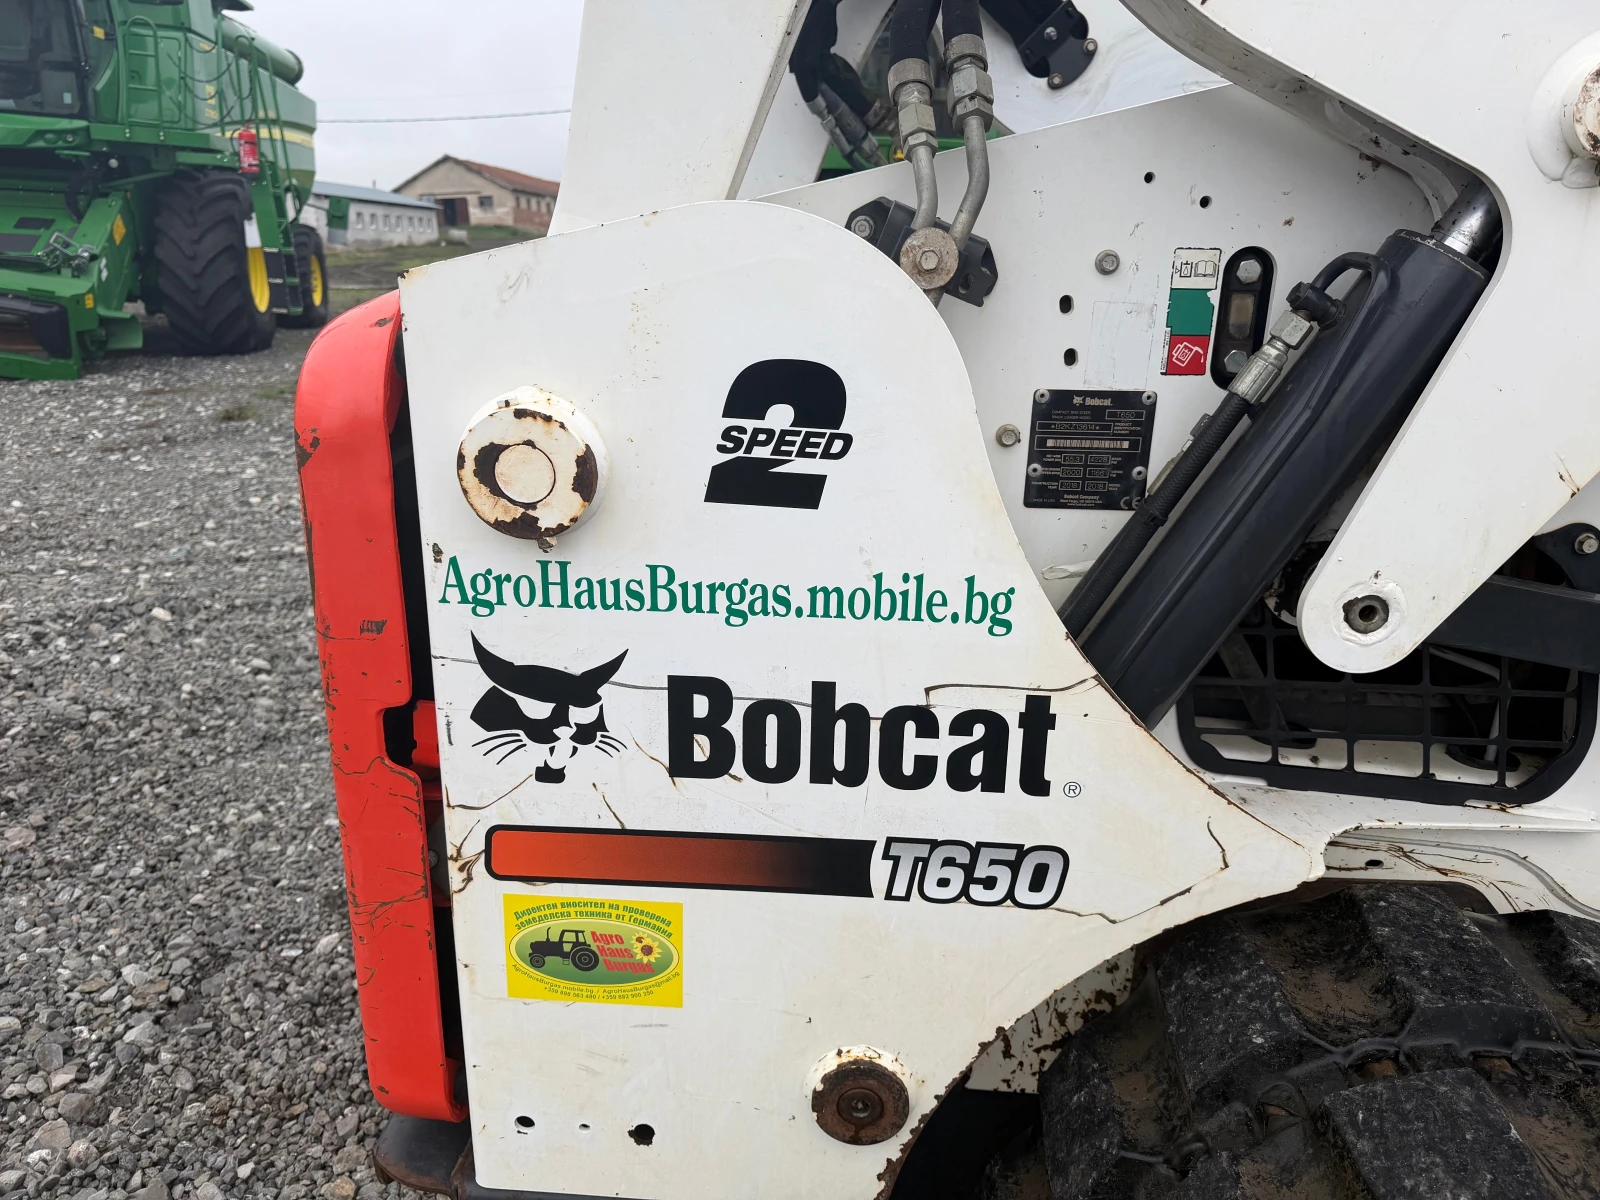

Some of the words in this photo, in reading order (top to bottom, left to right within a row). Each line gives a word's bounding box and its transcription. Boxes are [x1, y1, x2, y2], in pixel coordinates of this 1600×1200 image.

[704, 359, 847, 510] 2
[715, 425, 854, 461] SPEED
[439, 555, 1015, 637] AgroHausBurgas.mobile.bg
[667, 674, 1058, 797] Bobcat
[882, 837, 1071, 910] T650
[513, 902, 558, 921] Директен
[560, 901, 605, 910] вносител
[609, 903, 620, 911] на
[622, 906, 672, 927] проверена
[515, 910, 571, 930] земеделска
[574, 910, 613, 919] техника
[615, 913, 626, 921] от
[628, 915, 673, 939] Германия
[590, 930, 625, 946] Agro
[596, 944, 634, 959] Haus
[602, 957, 655, 975] Burgas
[544, 987, 559, 995] +359
